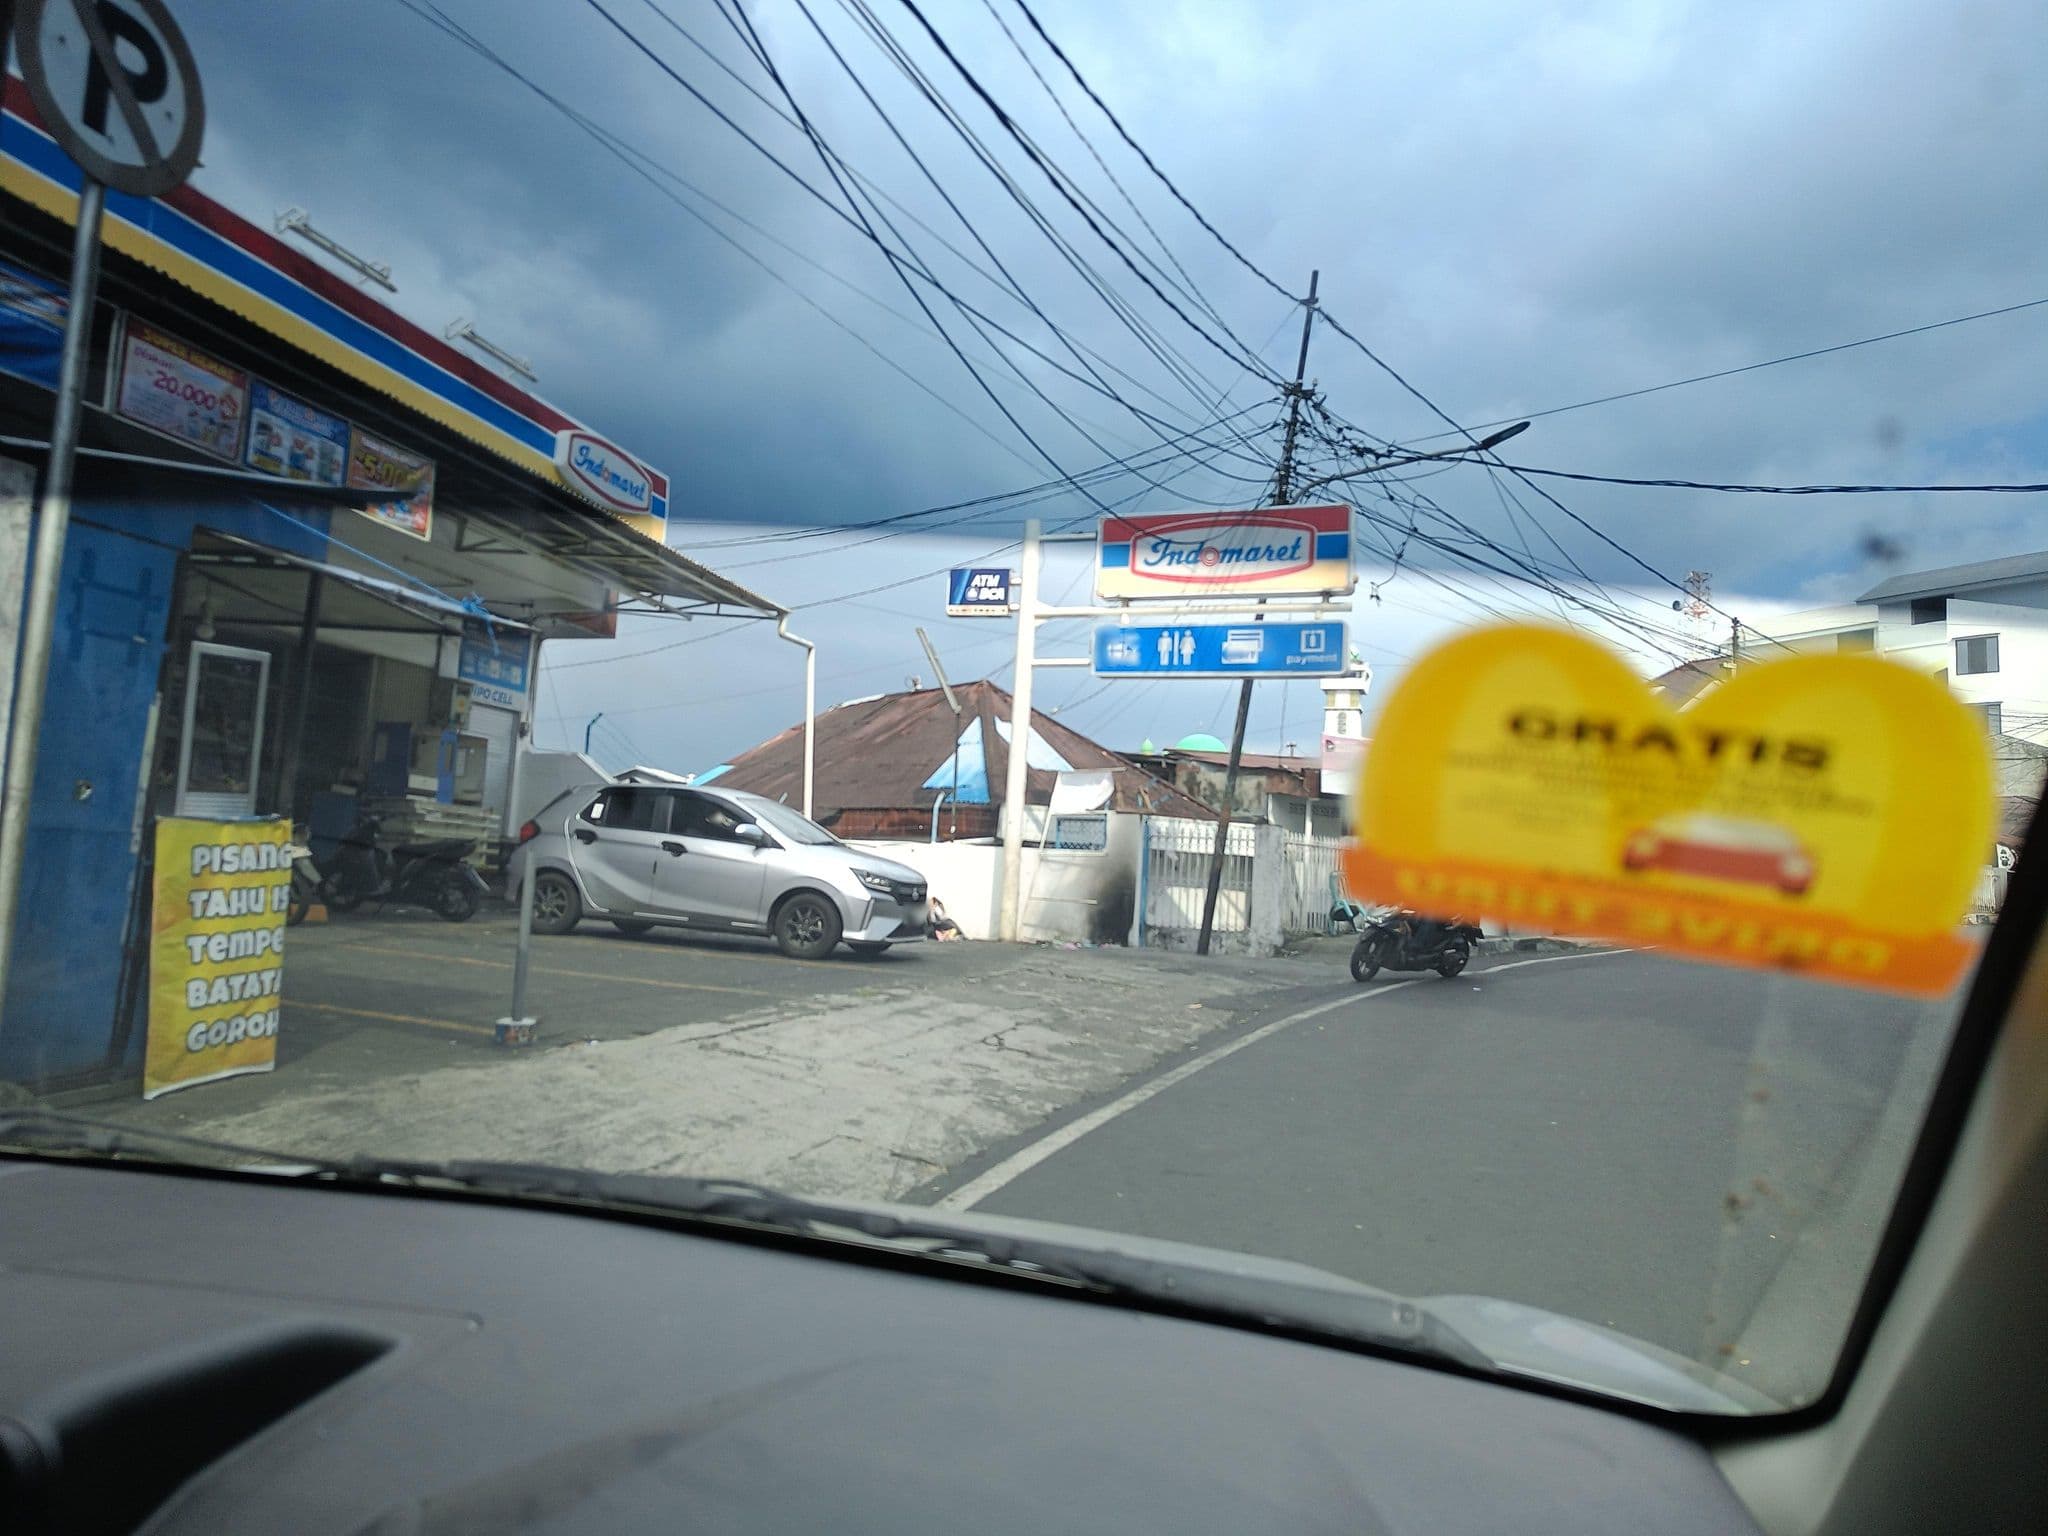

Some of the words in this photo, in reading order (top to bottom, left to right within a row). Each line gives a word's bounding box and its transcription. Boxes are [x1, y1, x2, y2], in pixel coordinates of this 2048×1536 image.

[574, 445, 646, 501] Indomaret
[1144, 535, 1301, 567] Indomaret
[970, 574, 1001, 588] ATM
[1507, 704, 1834, 770] GRATIS
[188, 886, 266, 919] TAHU
